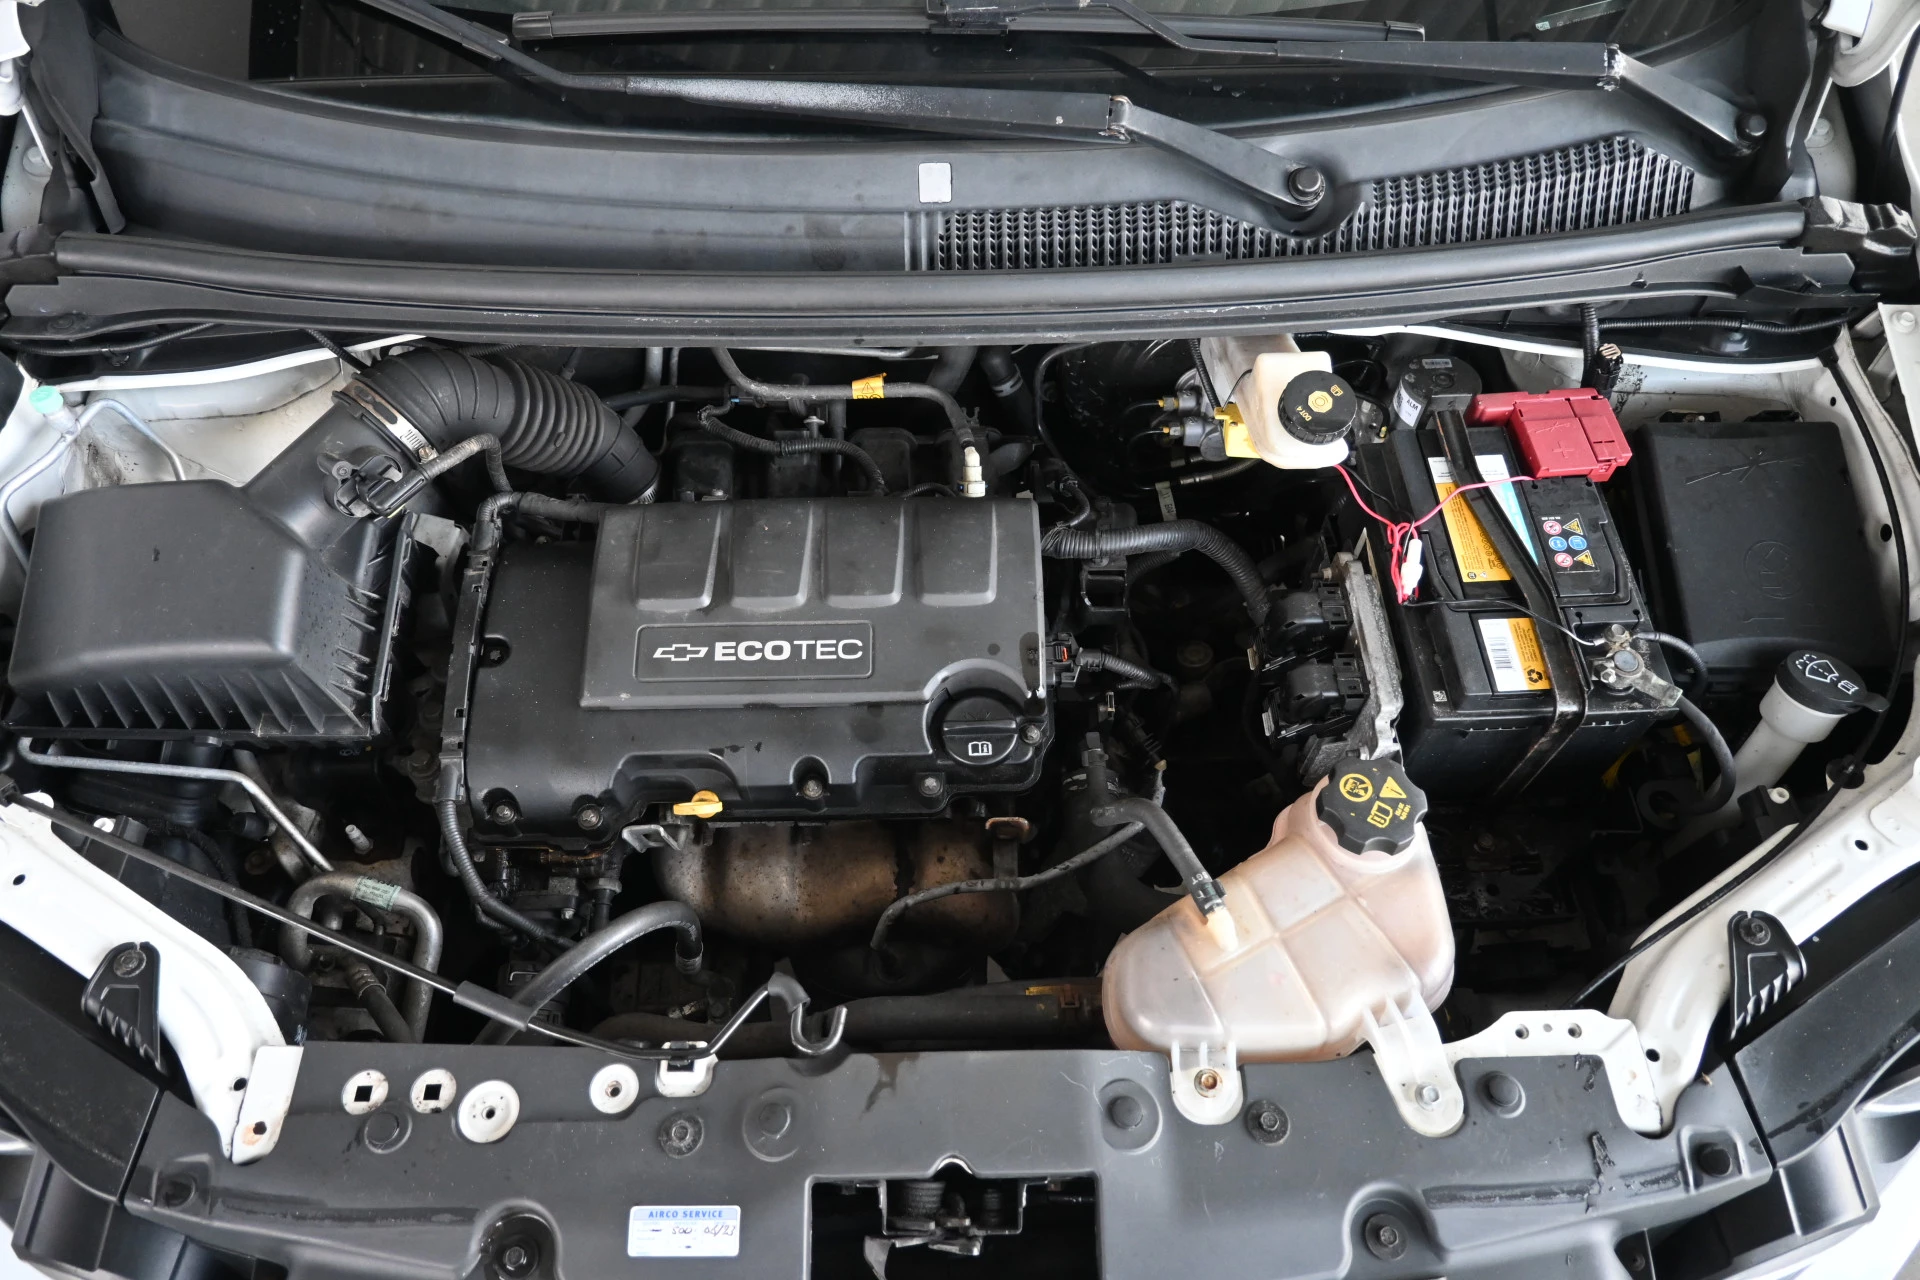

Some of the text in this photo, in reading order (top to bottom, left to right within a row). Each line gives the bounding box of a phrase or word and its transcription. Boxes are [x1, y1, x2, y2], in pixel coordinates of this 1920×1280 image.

[1300, 410, 1312, 421] DOT
[714, 639, 863, 662] ECOTEC
[648, 1210, 723, 1219] AIRCO SERVICE
